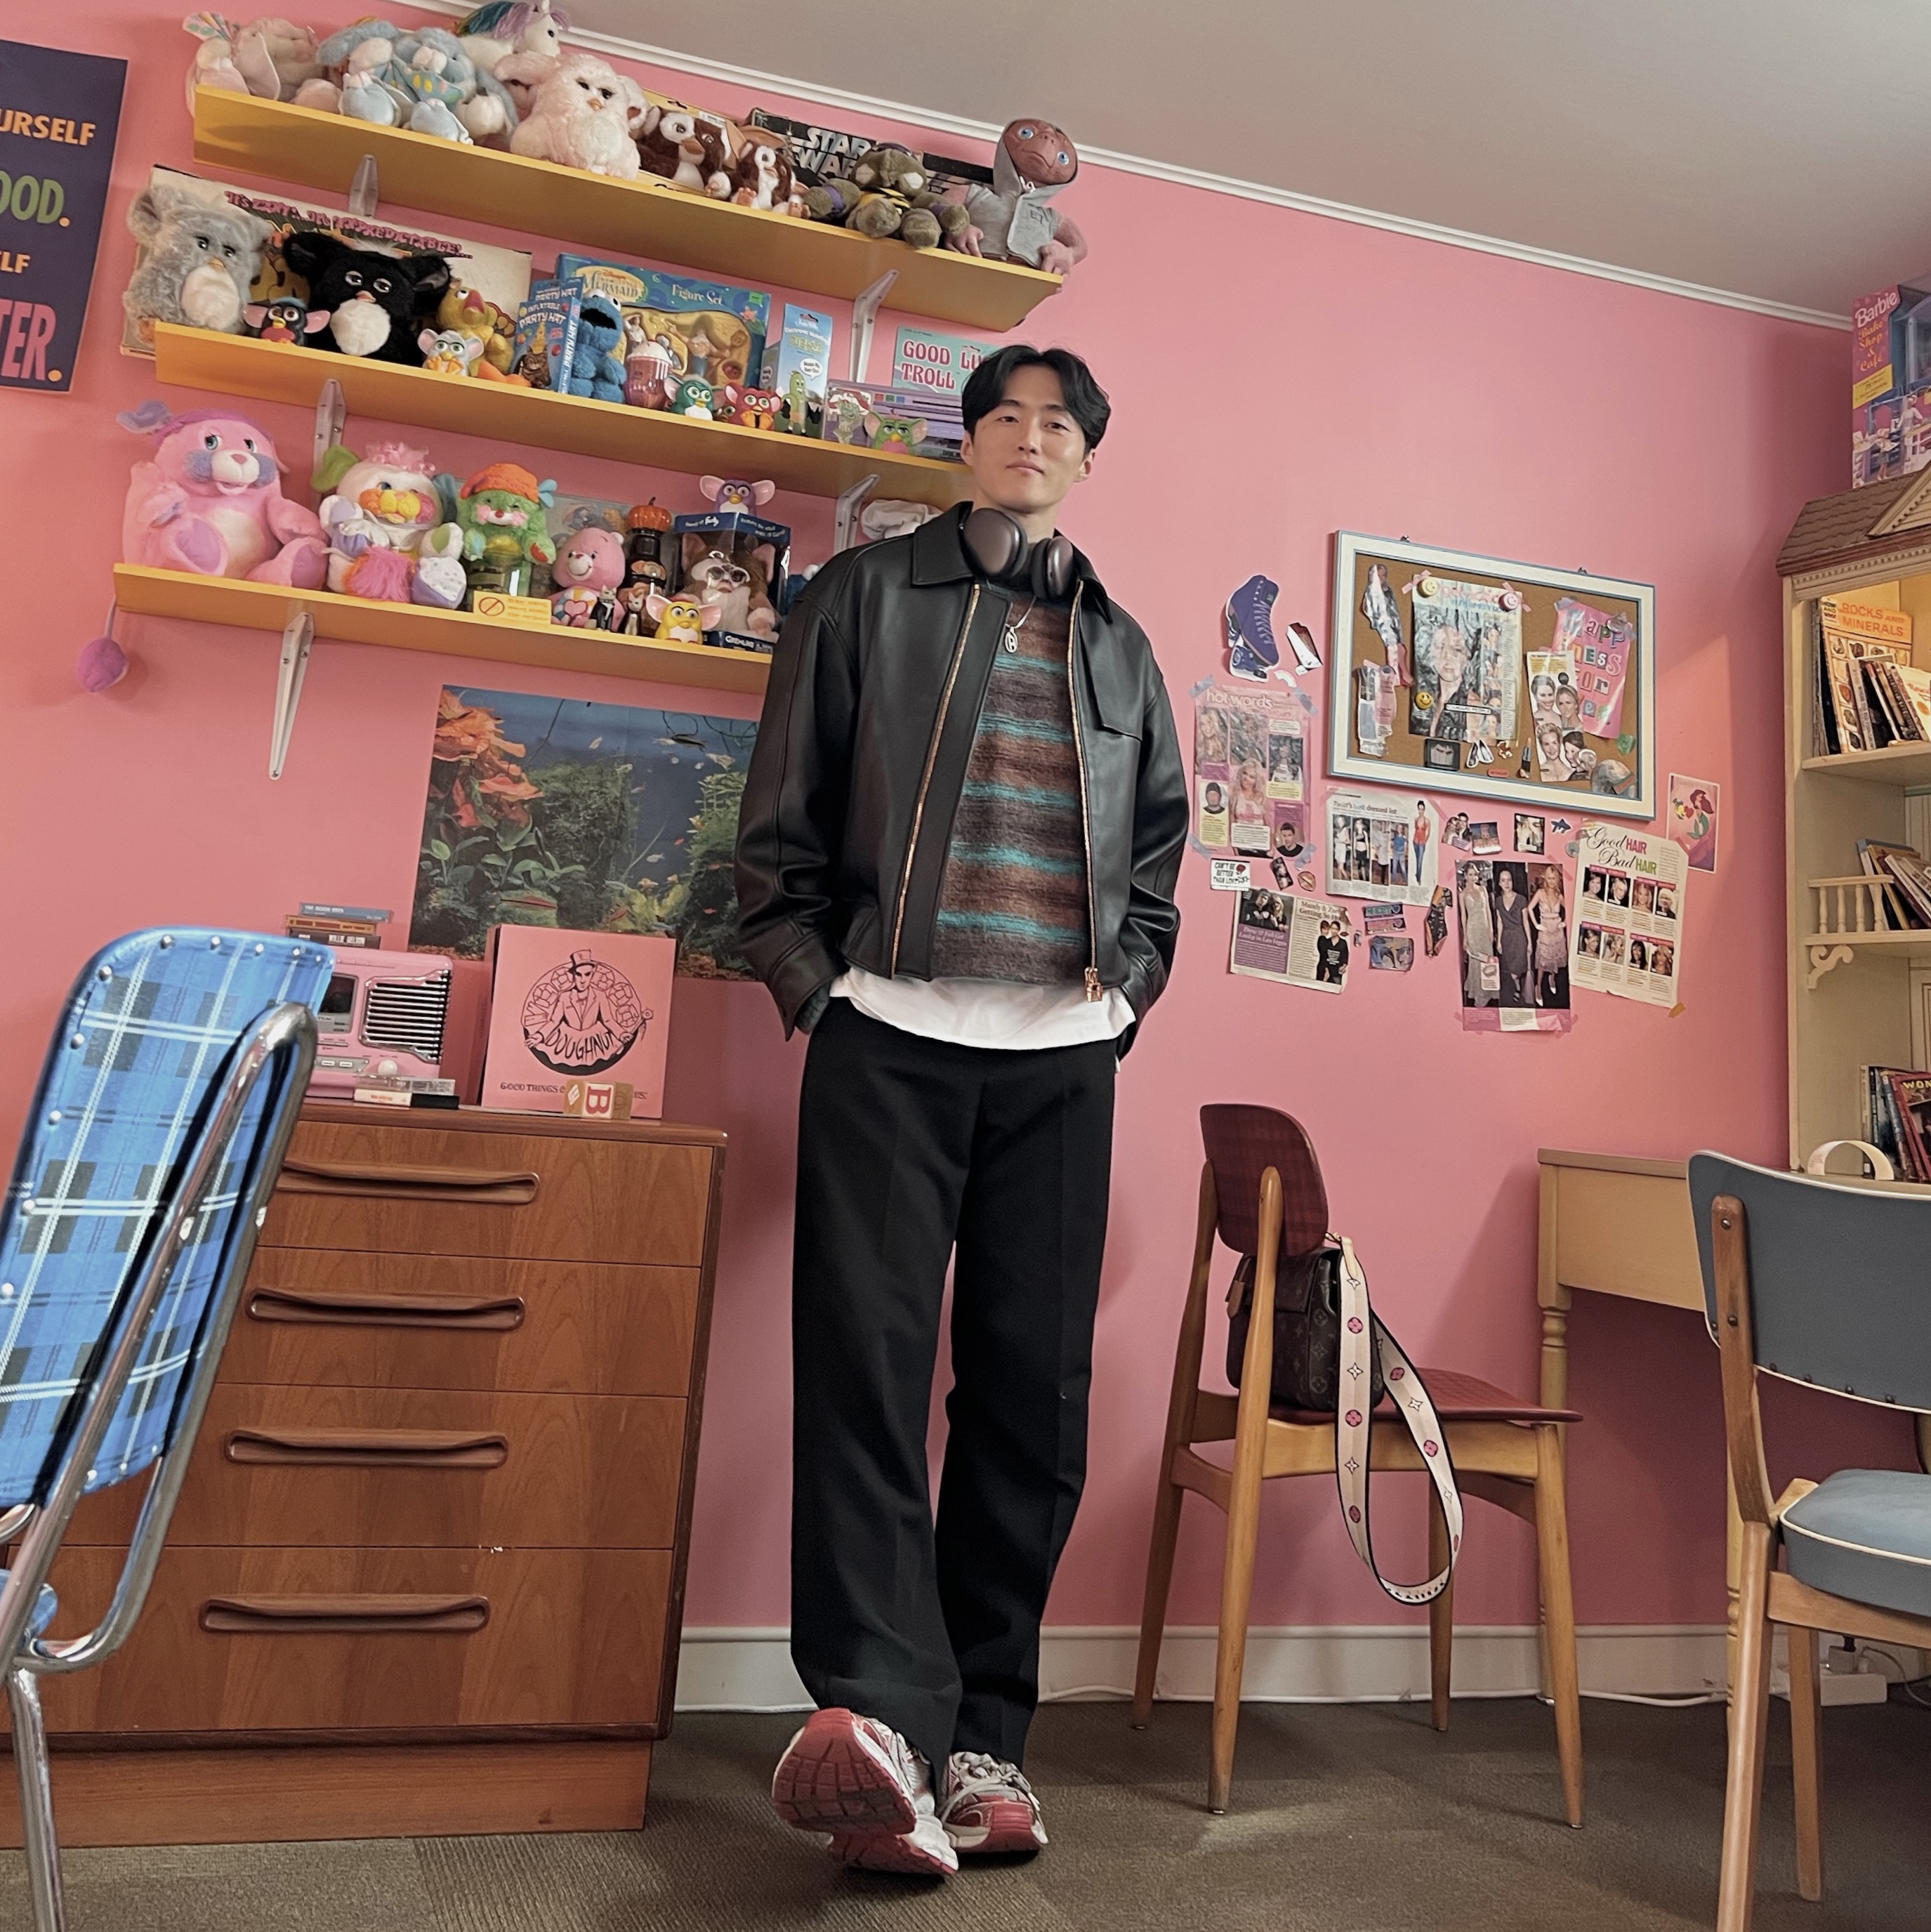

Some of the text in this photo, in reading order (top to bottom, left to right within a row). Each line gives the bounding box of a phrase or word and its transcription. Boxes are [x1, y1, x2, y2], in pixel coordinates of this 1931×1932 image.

[791, 126, 872, 159] STAR
[0, 251, 30, 273] LF
[535, 287, 578, 301] PARTY HAT
[582, 270, 638, 297] MERMAID
[672, 283, 724, 306] Figure Set
[519, 312, 567, 329] PARTY HAT
[1855, 292, 1897, 328] Barbie
[1859, 320, 1884, 340] Bake
[1859, 333, 1883, 351] Shop
[903, 341, 982, 372] GOOD LU
[1860, 353, 1883, 372] Café
[902, 362, 955, 390] TROLL
[1841, 602, 1904, 624] ROCKS AND
[1843, 616, 1904, 637] MINERALS
[1206, 688, 1274, 710] hot words
[1366, 804, 1388, 813] dressed
[1587, 827, 1647, 855] Good HAIR
[1597, 846, 1637, 869] Bad
[1635, 857, 1657, 875] HAIR
[1301, 900, 1321, 912] Mandy
[544, 1027, 615, 1063] DOUGHNUT
[500, 1082, 526, 1091] GOOD
[527, 1084, 558, 1093] THINGS
